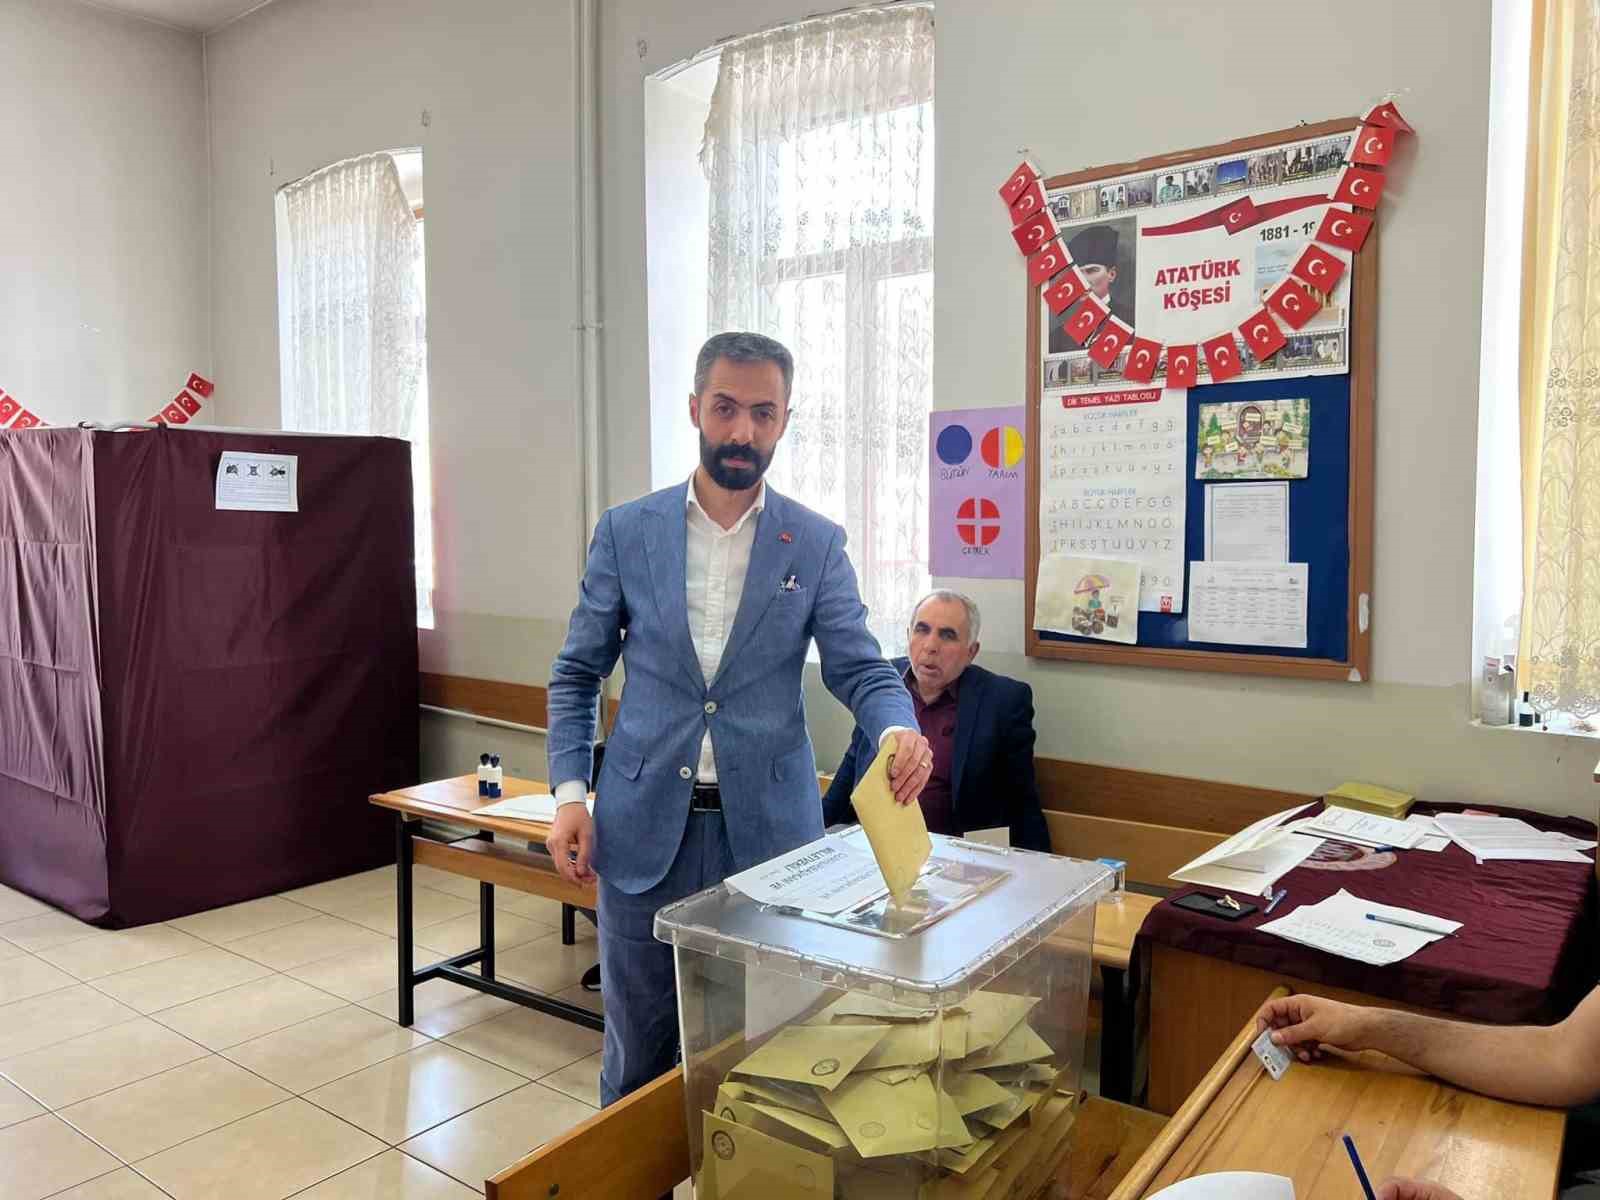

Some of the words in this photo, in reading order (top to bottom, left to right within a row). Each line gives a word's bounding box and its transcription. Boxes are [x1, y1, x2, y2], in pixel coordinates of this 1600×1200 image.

[1260, 225, 1289, 242] 1881
[1155, 259, 1240, 286] ATATÜRK
[1164, 281, 1231, 310] KÖŞESİ
[1080, 395, 1101, 405] TEMEL
[1123, 391, 1156, 402] TABLOSU
